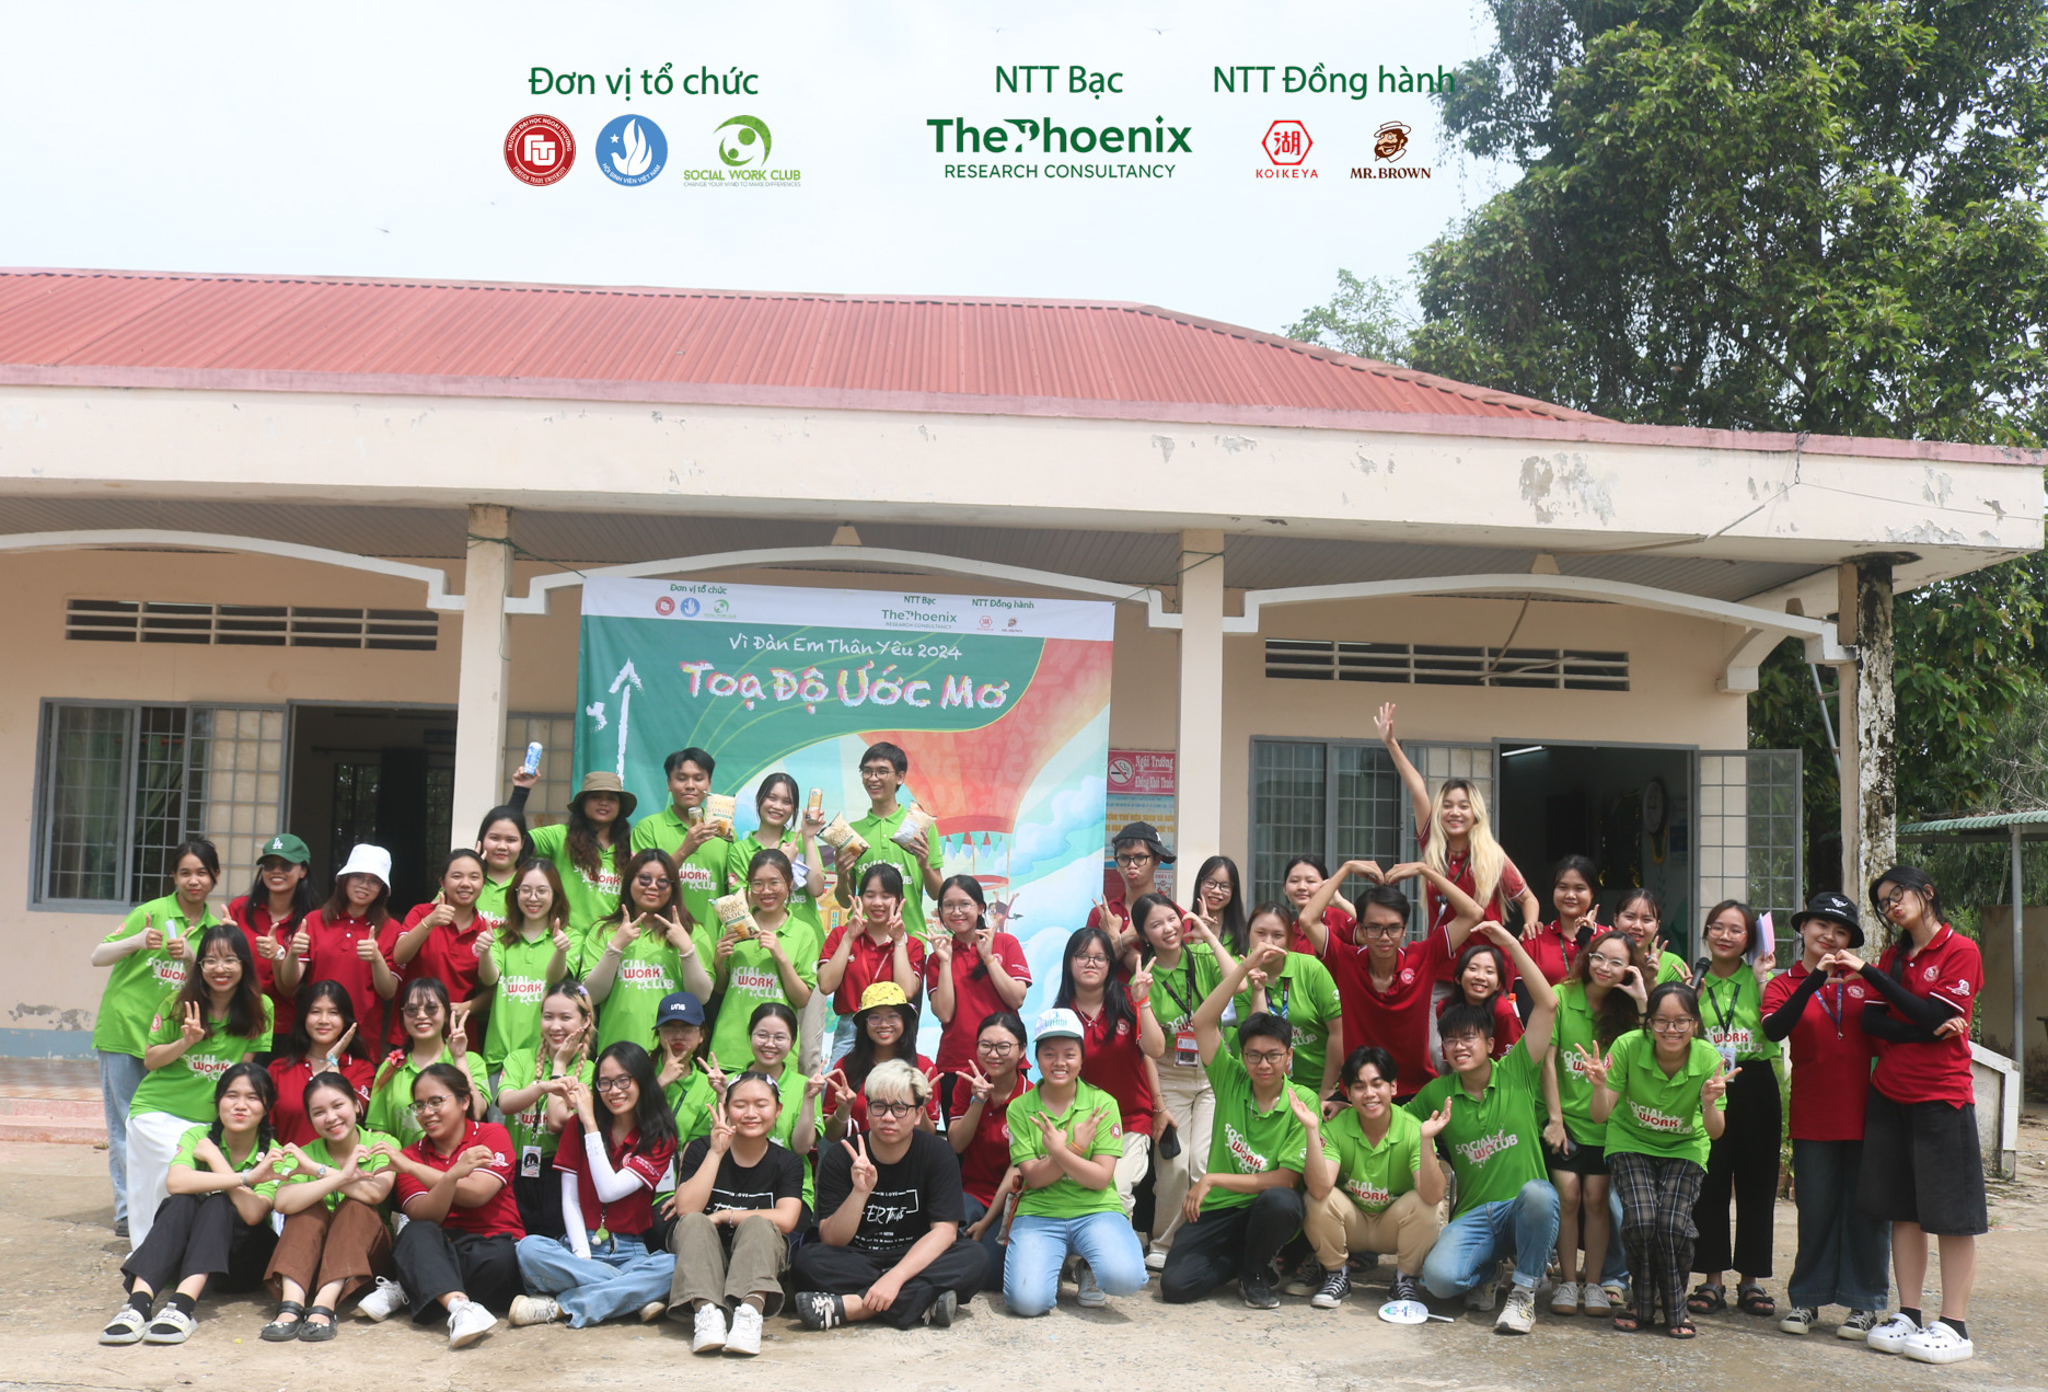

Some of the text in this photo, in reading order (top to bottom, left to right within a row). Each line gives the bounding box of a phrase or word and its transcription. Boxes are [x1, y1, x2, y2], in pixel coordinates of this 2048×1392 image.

[904, 595, 921, 604] NTT
[972, 598, 988, 607] NTT
[729, 633, 963, 661] Vì Đàn Em Thân Yêu 2024
[623, 968, 661, 979] WORK
[738, 975, 774, 988] WORK
[507, 983, 542, 993] WORK
[1713, 1032, 1749, 1044] WORK
[1638, 1112, 1678, 1128] WORK
[1231, 1140, 1263, 1169] WORK
